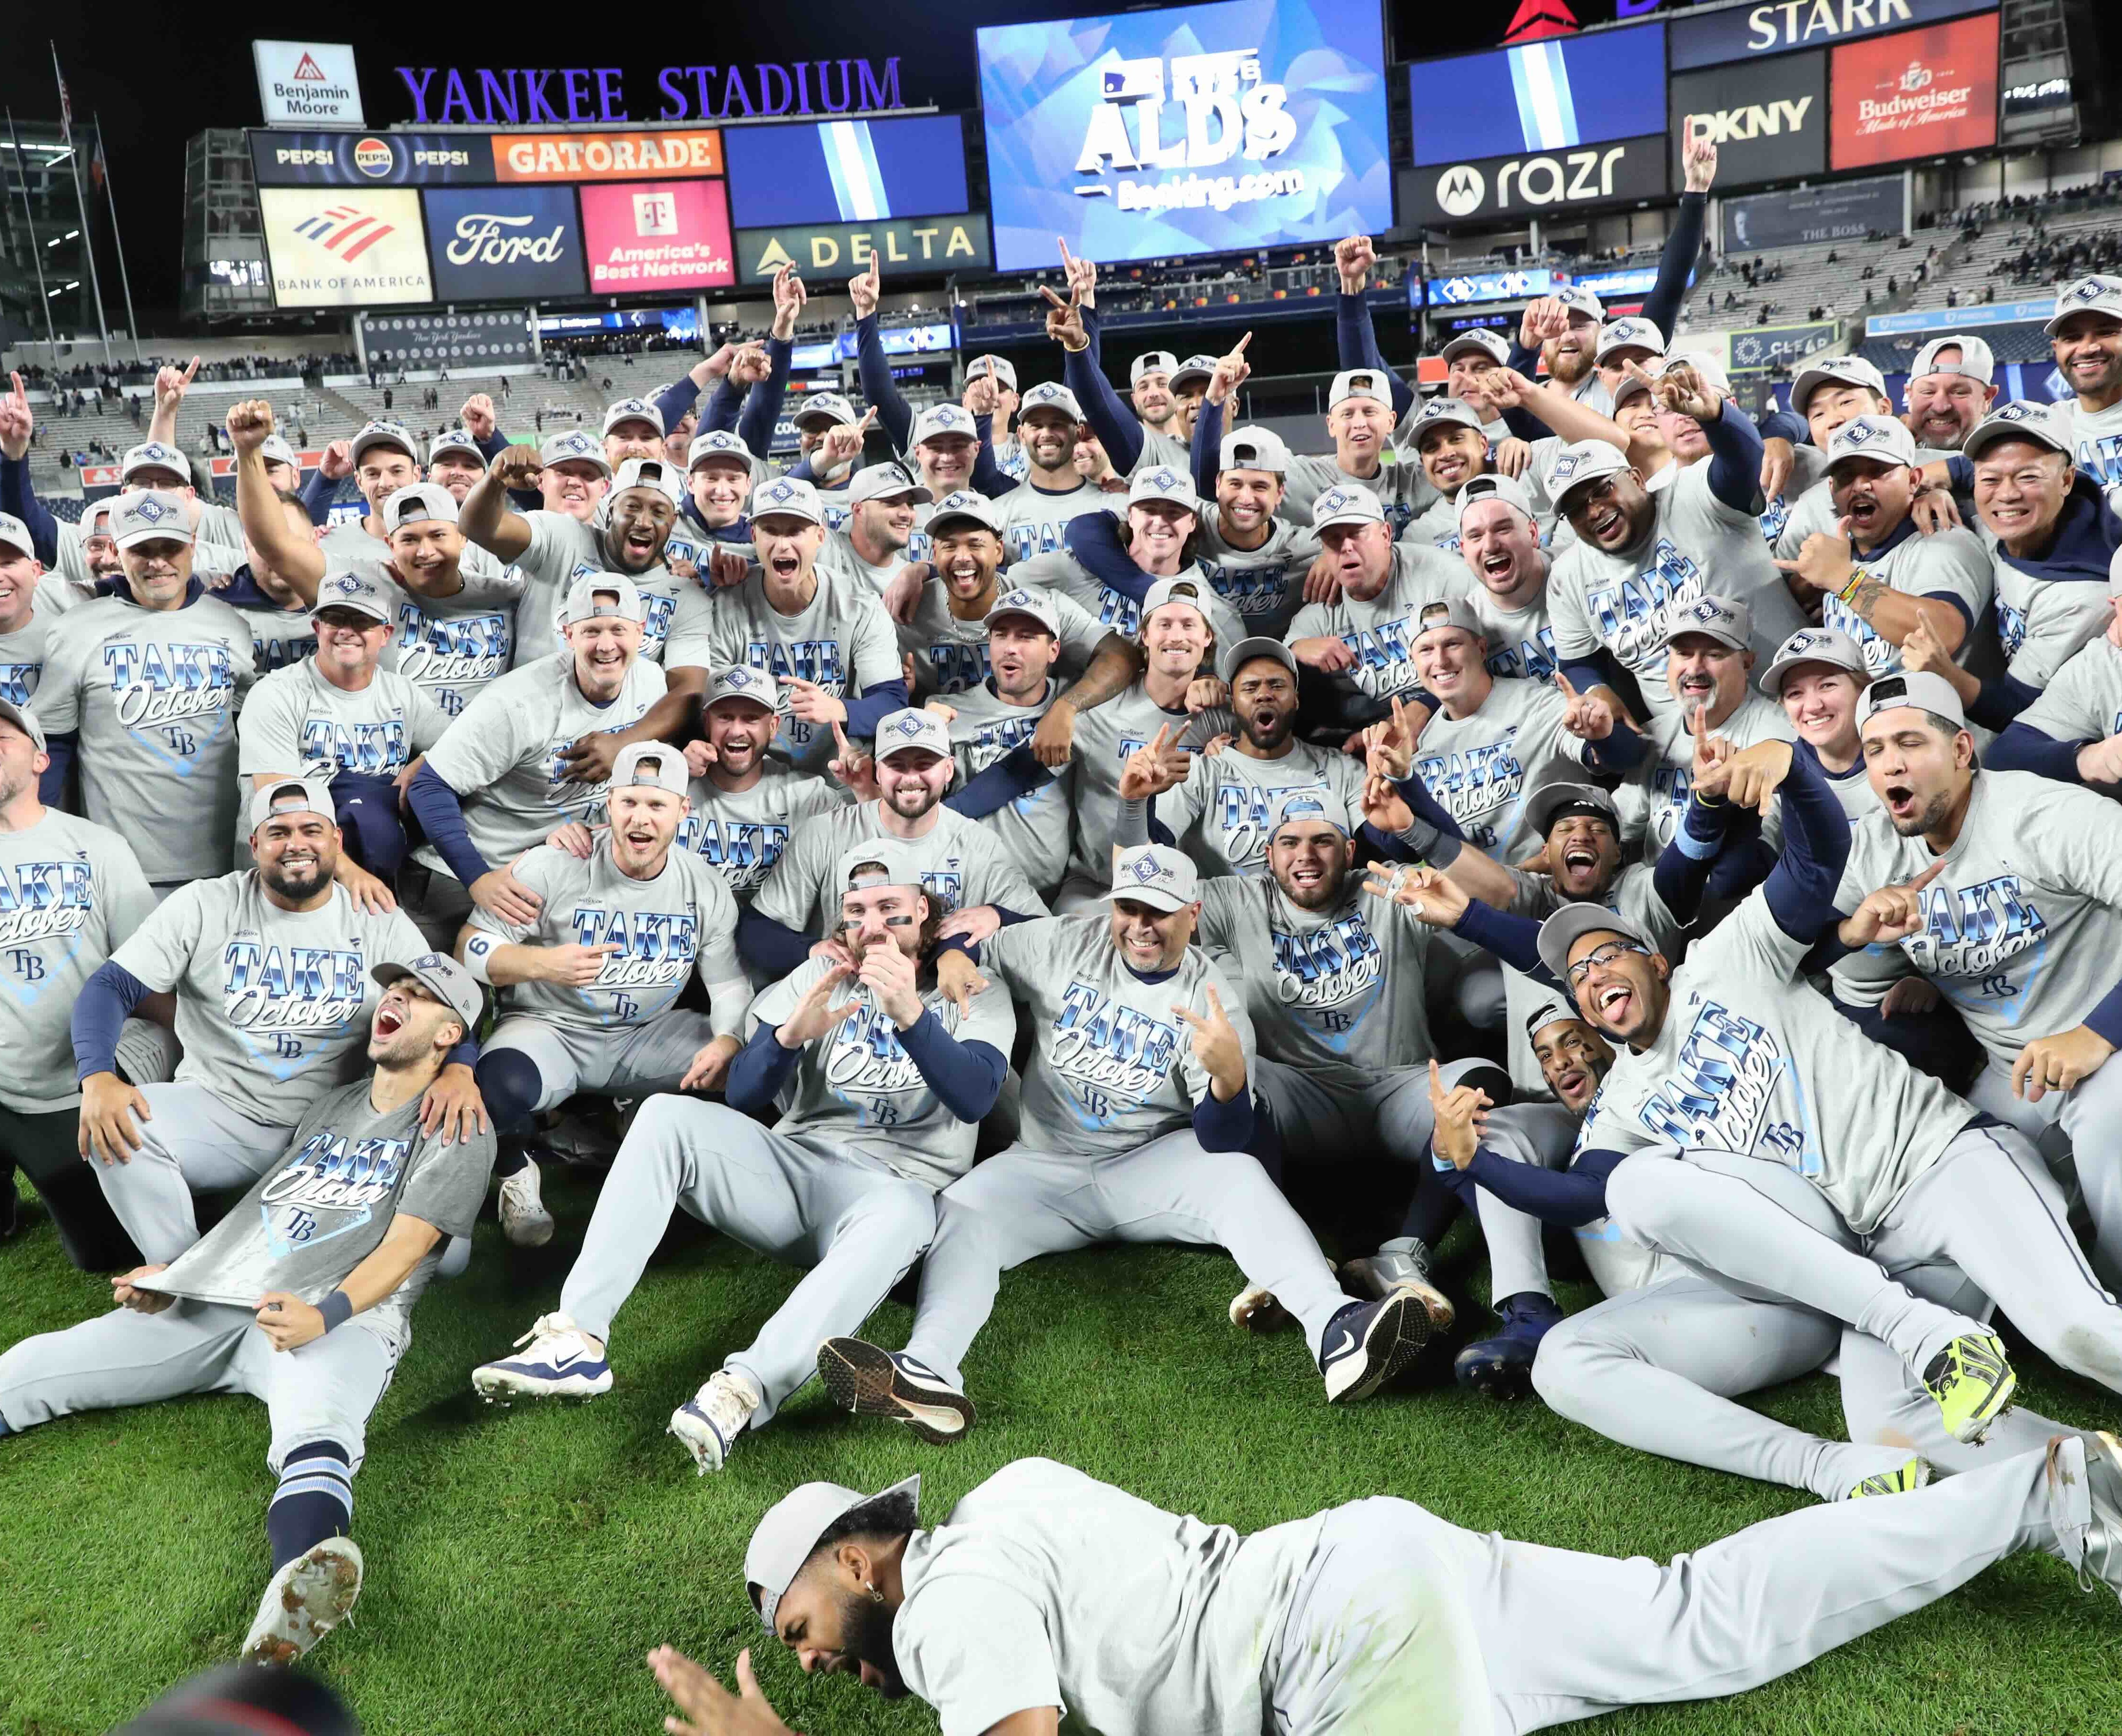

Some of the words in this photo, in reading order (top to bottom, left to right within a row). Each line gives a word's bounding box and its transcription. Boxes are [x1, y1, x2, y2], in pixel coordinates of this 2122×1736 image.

[274, 83, 349, 104] Benjamin
[286, 99, 339, 115] Moore
[395, 67, 628, 124] YANKEE
[658, 56, 906, 120] STADIUM
[1858, 86, 1971, 121] Budweiser
[1075, 84, 1297, 172] ALDS
[1688, 96, 1814, 144] DKNY
[1855, 117, 1896, 136] Made
[1898, 114, 1913, 130] of
[276, 149, 334, 165] PEPSI
[357, 152, 391, 163] PEPSI
[415, 151, 469, 166] PEPSI
[507, 137, 712, 174] GATORADE
[1497, 146, 1625, 208] razr
[446, 213, 565, 266] Ford
[810, 226, 975, 268] DELTA
[1801, 227, 1828, 241] THE
[1832, 223, 1866, 237] BOSS
[594, 262, 643, 281] Best
[645, 260, 729, 278] Network
[608, 242, 710, 263] America's
[278, 279, 323, 291] BANK
[327, 278, 350, 290] OF
[353, 276, 426, 288] AMERICA
[2083, 284, 2100, 297] TB
[1770, 337, 1827, 355] CLEAR
[1852, 424, 1868, 439] TB
[144, 503, 160, 515] TB
[1011, 522, 1072, 562] TA
[343, 577, 357, 591] TB
[1587, 537, 1700, 635] TAKE
[1698, 603, 1713, 615] TB
[398, 602, 509, 658] TAKE
[104, 643, 231, 692] TAKE
[396, 641, 503, 682] October
[733, 671, 747, 683] TB
[749, 640, 846, 684] TAKE
[114, 676, 233, 726] October
[435, 687, 463, 716] TB
[162, 726, 197, 756] TB
[784, 715, 811, 744] TB
[904, 718, 918, 731] TB
[304, 719, 408, 768] TAKE
[1421, 739, 1523, 793] TAKE
[1431, 769, 1523, 816] October
[676, 815, 789, 870] TAKE
[1466, 821, 1498, 848] TB
[1140, 860, 1153, 875] TB
[0, 861, 91, 911] AKE
[0, 894, 88, 938] ctober
[468, 937, 489, 957] 6
[572, 908, 698, 963] TAKE
[1271, 910, 1378, 985] TAKE
[6, 949, 46, 981] TB
[224, 942, 364, 1004] TAKE
[1276, 952, 1383, 1006] October
[1981, 974, 2020, 998] TB
[224, 984, 361, 1027] October
[609, 992, 639, 1020] TB
[1316, 1010, 1353, 1032] TB
[268, 1032, 303, 1059] TB
[1053, 981, 1182, 1079] TAKE
[1048, 1027, 1165, 1094] October
[1638, 999, 1766, 1145] TAKE
[866, 1095, 898, 1126] TB
[1076, 1081, 1109, 1119] TB
[1761, 1120, 1806, 1156] TB
[286, 1132, 414, 1189] TAKE
[260, 1164, 390, 1206] October
[284, 1206, 318, 1242] TB
